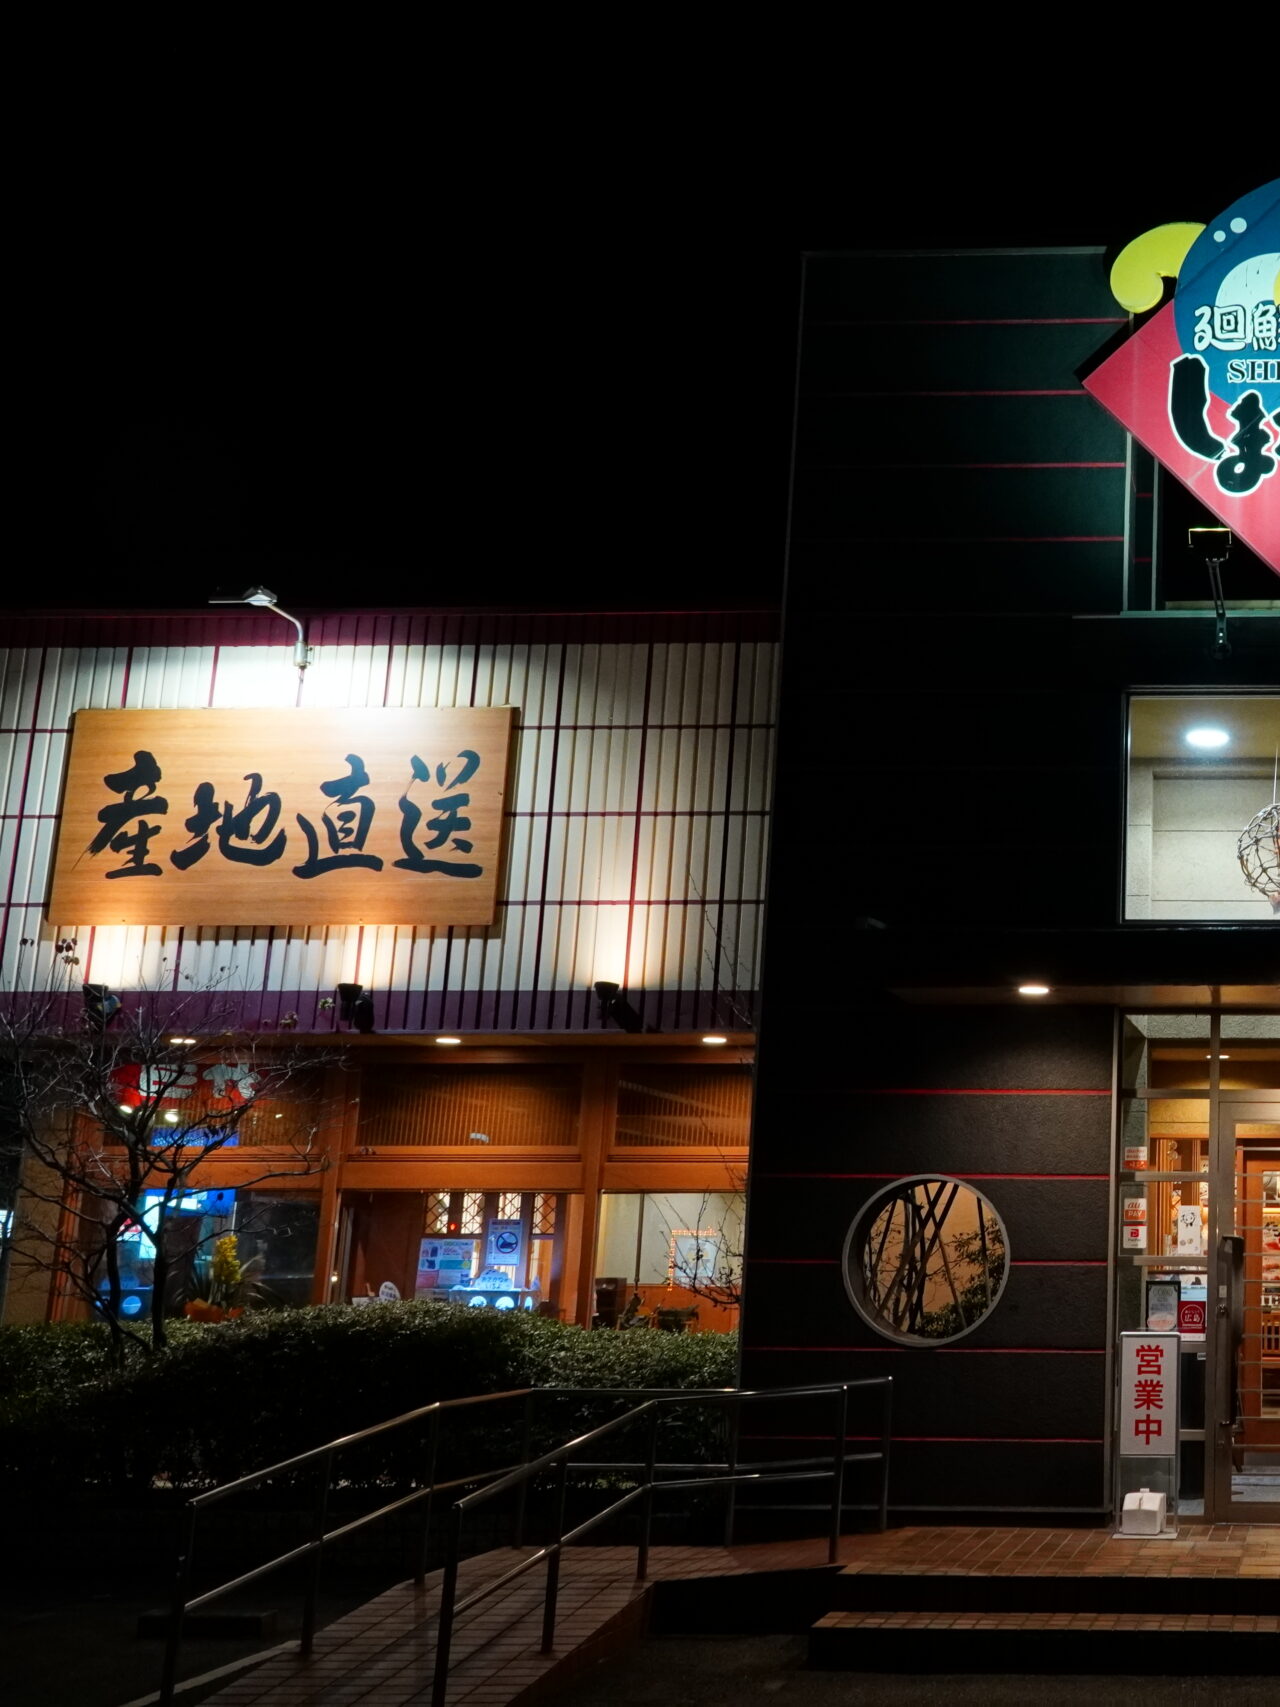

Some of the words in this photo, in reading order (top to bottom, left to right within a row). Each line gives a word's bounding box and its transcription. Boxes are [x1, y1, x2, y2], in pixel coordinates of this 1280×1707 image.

[71, 749, 484, 879] 産地直送
[1133, 1344, 1165, 1446] 営業中
